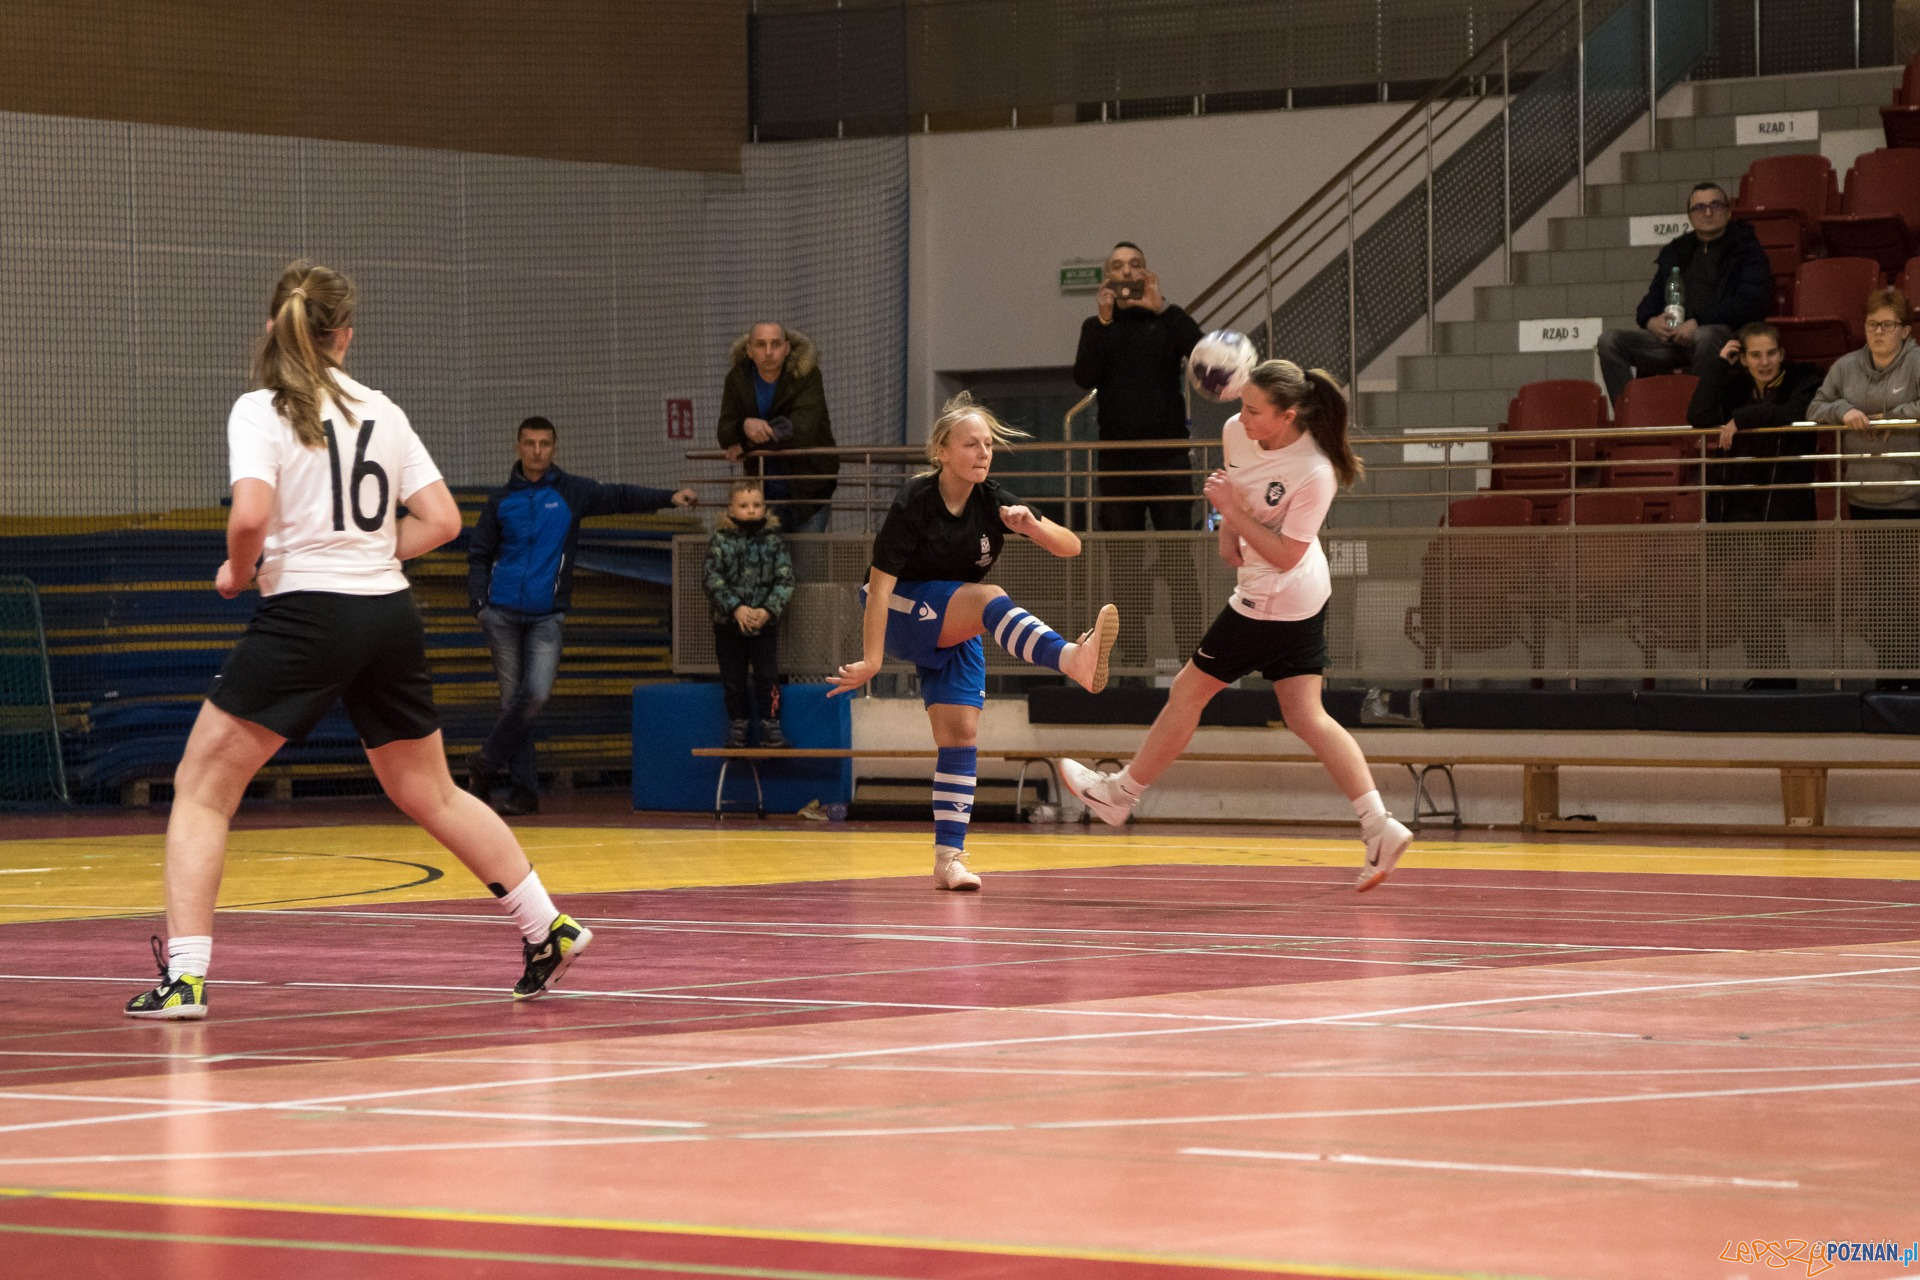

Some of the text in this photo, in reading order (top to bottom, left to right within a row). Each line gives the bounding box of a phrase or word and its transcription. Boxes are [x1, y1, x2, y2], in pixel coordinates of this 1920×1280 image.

[1758, 120, 1794, 135] RZĄD 1
[1682, 222, 1689, 232] 2
[1542, 327, 1579, 341] RZĄD 3
[323, 419, 389, 532] 16
